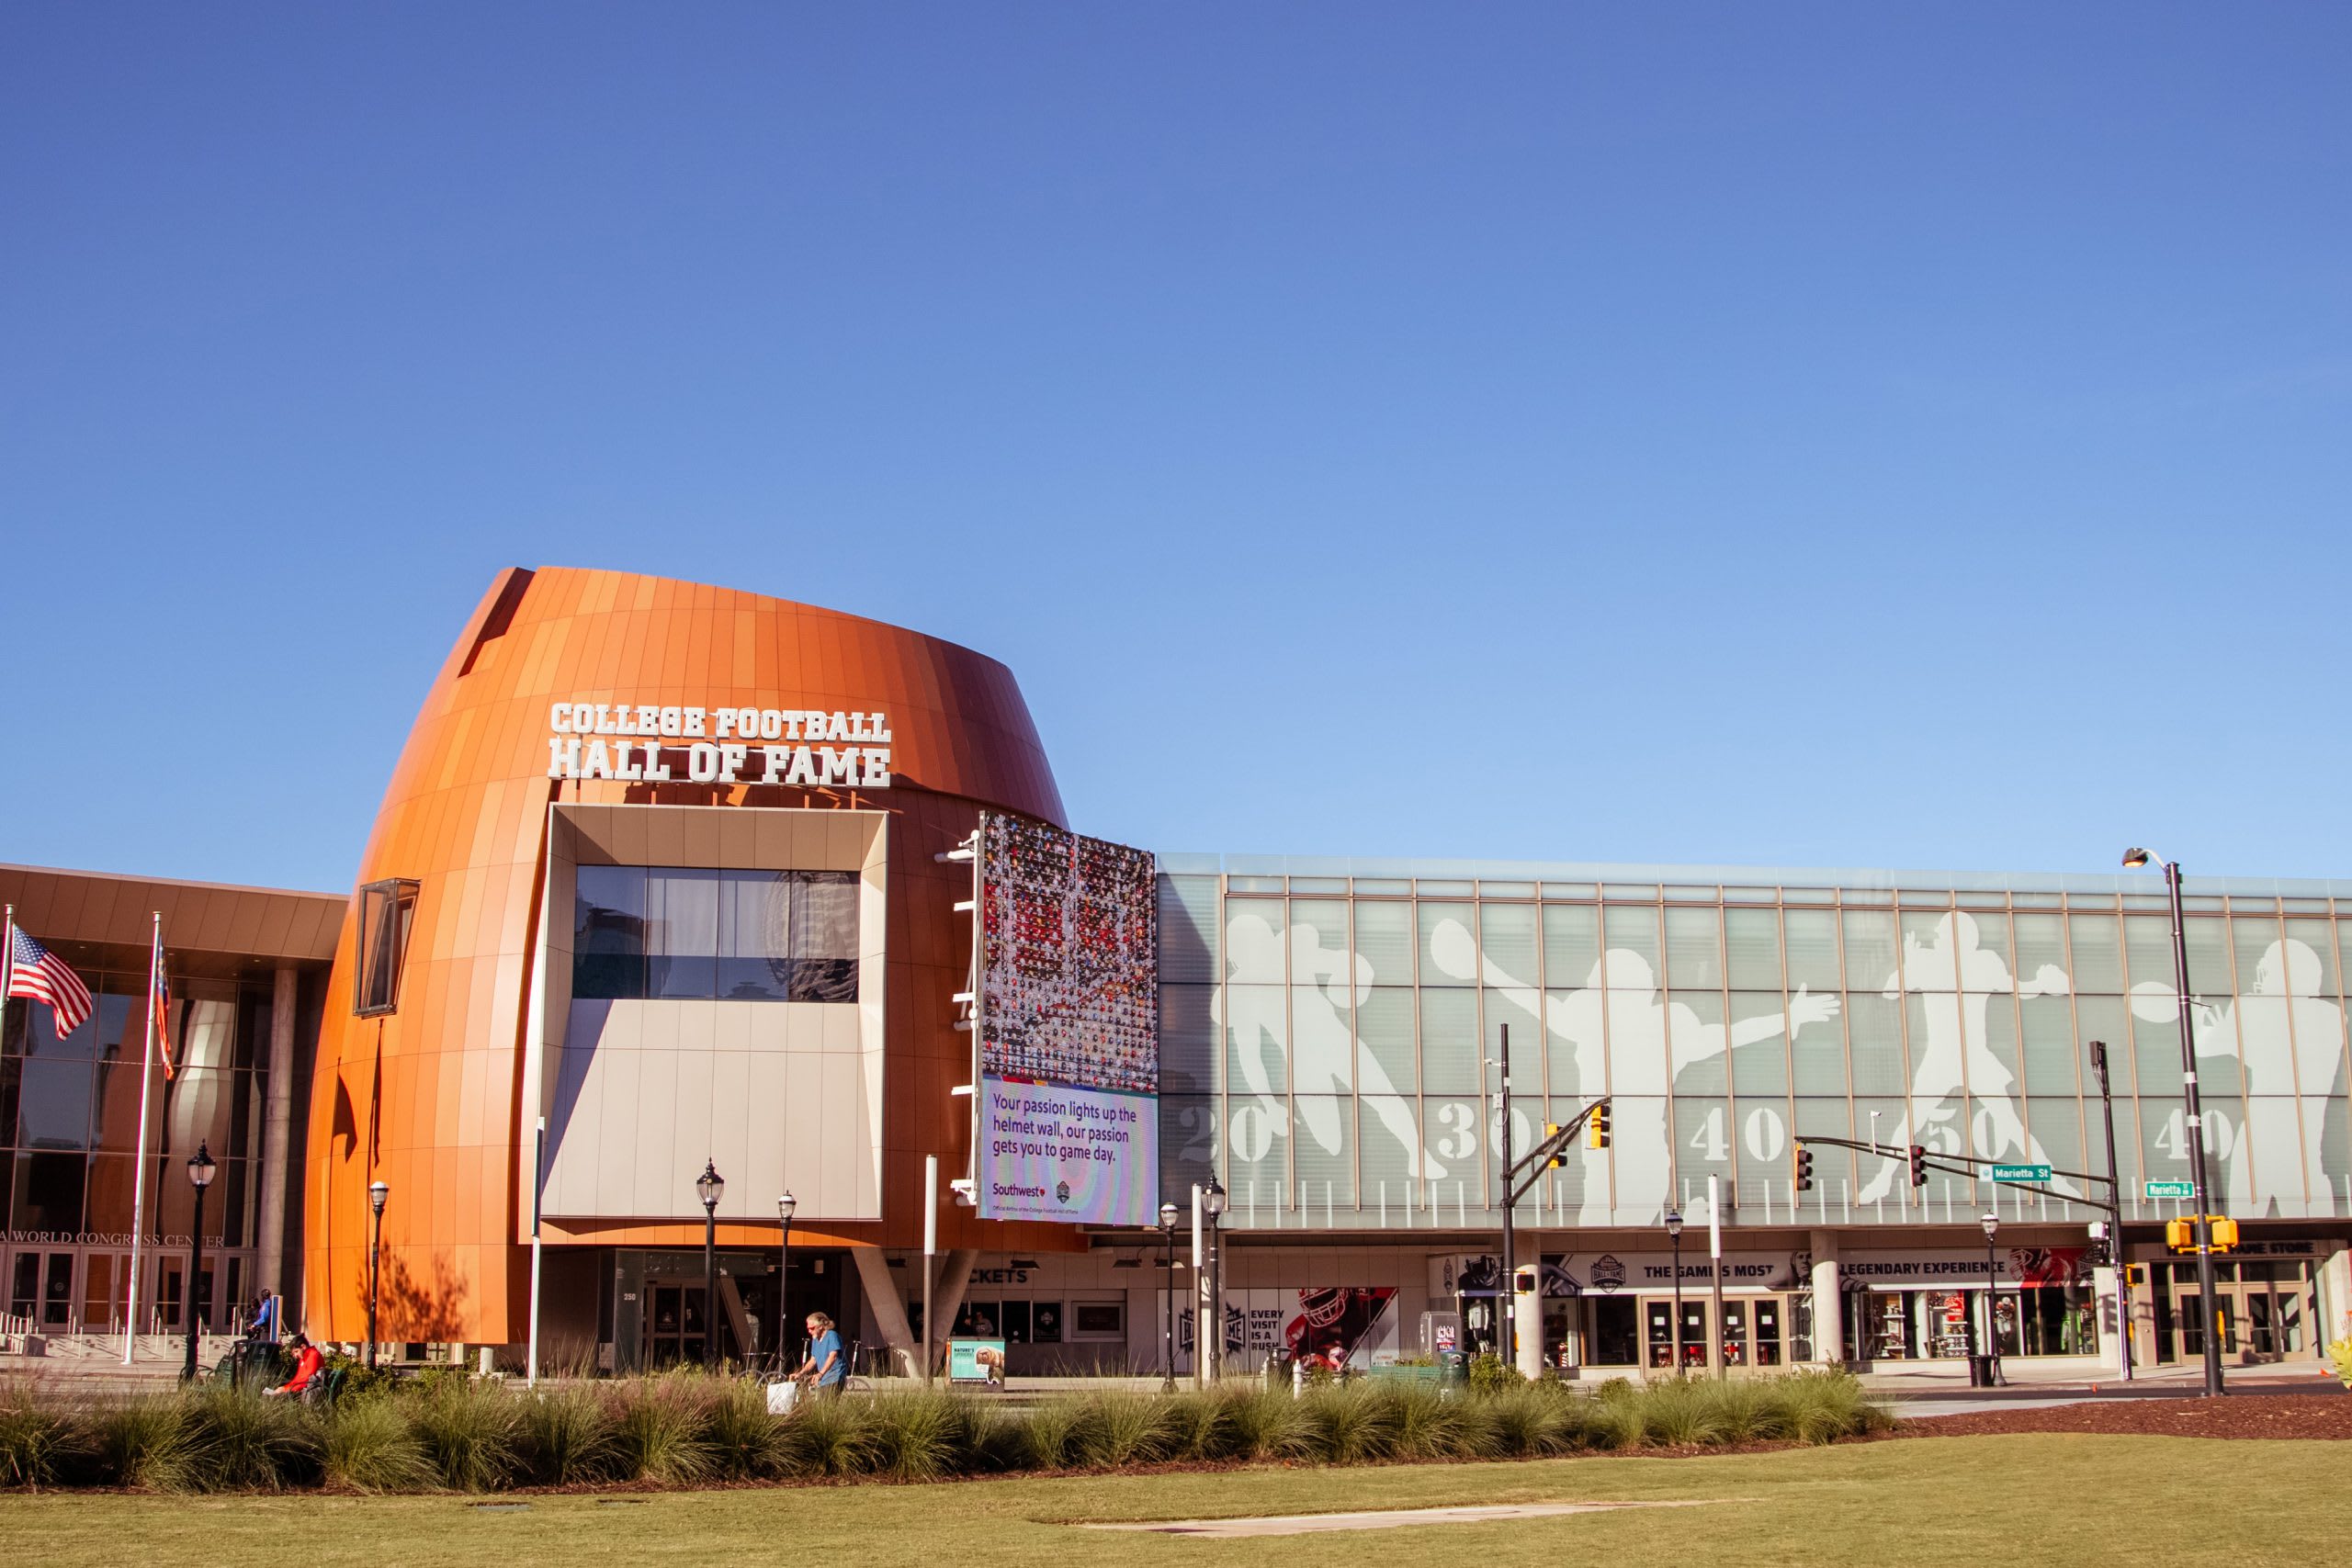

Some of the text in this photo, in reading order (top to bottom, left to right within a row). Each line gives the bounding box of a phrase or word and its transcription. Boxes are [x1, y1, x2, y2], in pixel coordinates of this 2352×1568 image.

[550, 703, 891, 742] COLLEGE FOOTBALL
[548, 738, 891, 787] HALL OF FAME
[993, 1093, 1136, 1123] Your passion lights up the
[993, 1115, 1129, 1143] helmet wall, our passion
[1179, 1106, 1272, 1162] 20
[1438, 1103, 1532, 1162] 30
[1690, 1108, 1784, 1161] 40
[1927, 1108, 2009, 1161] 50
[2154, 1109, 2233, 1161] 40
[993, 1140, 1116, 1165] gets you to game day.
[1996, 1168, 2049, 1178] Marietta St
[993, 1182, 1039, 1197] Southwest
[2150, 1185, 2181, 1195] Marietta
[13, 1230, 72, 1244] WORLD
[76, 1233, 160, 1246] CONGRSS
[164, 1235, 224, 1247] CENER
[2269, 1242, 2313, 1254] STORE
[969, 1269, 1027, 1283] CKETS
[1644, 1265, 1774, 1278] THE GAMS MOST
[1839, 1263, 1920, 1275] LEGENDARY
[624, 1292, 637, 1301] 250
[1251, 1310, 1284, 1318] EVERY
[1251, 1321, 1278, 1329] VISIT
